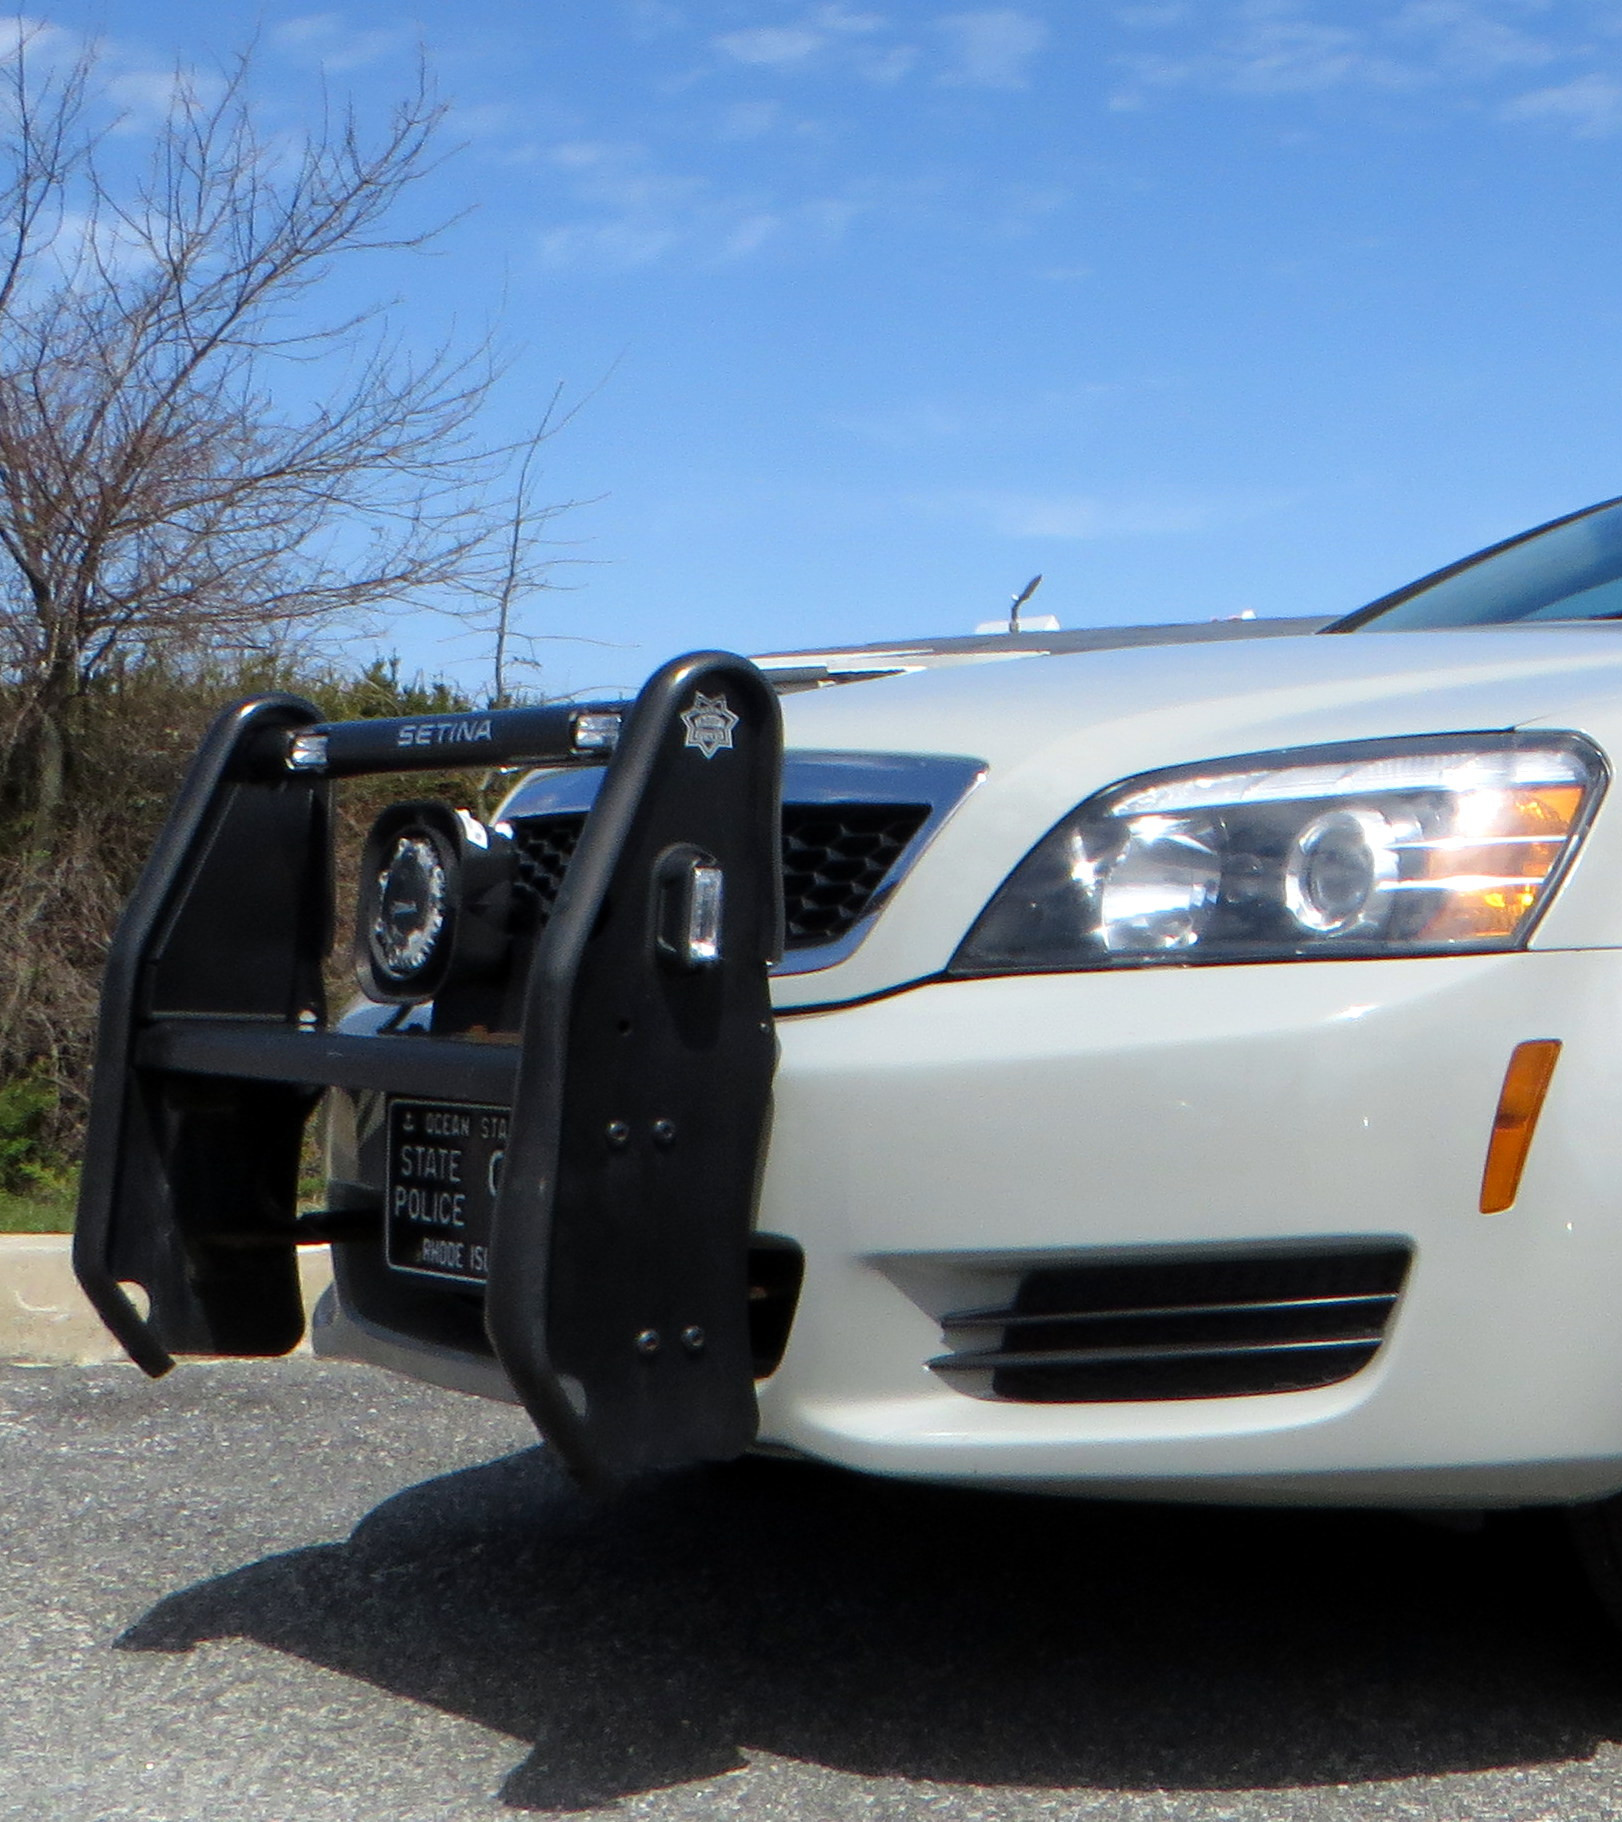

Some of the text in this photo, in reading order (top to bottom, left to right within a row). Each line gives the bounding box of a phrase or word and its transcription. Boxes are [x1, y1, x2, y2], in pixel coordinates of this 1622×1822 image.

[397, 720, 492, 746] SETINA
[425, 1112, 507, 1140] OCEAN STA
[401, 1145, 463, 1183] STATE
[394, 1185, 466, 1227] POLICE
[422, 1237, 465, 1269] RHODE
